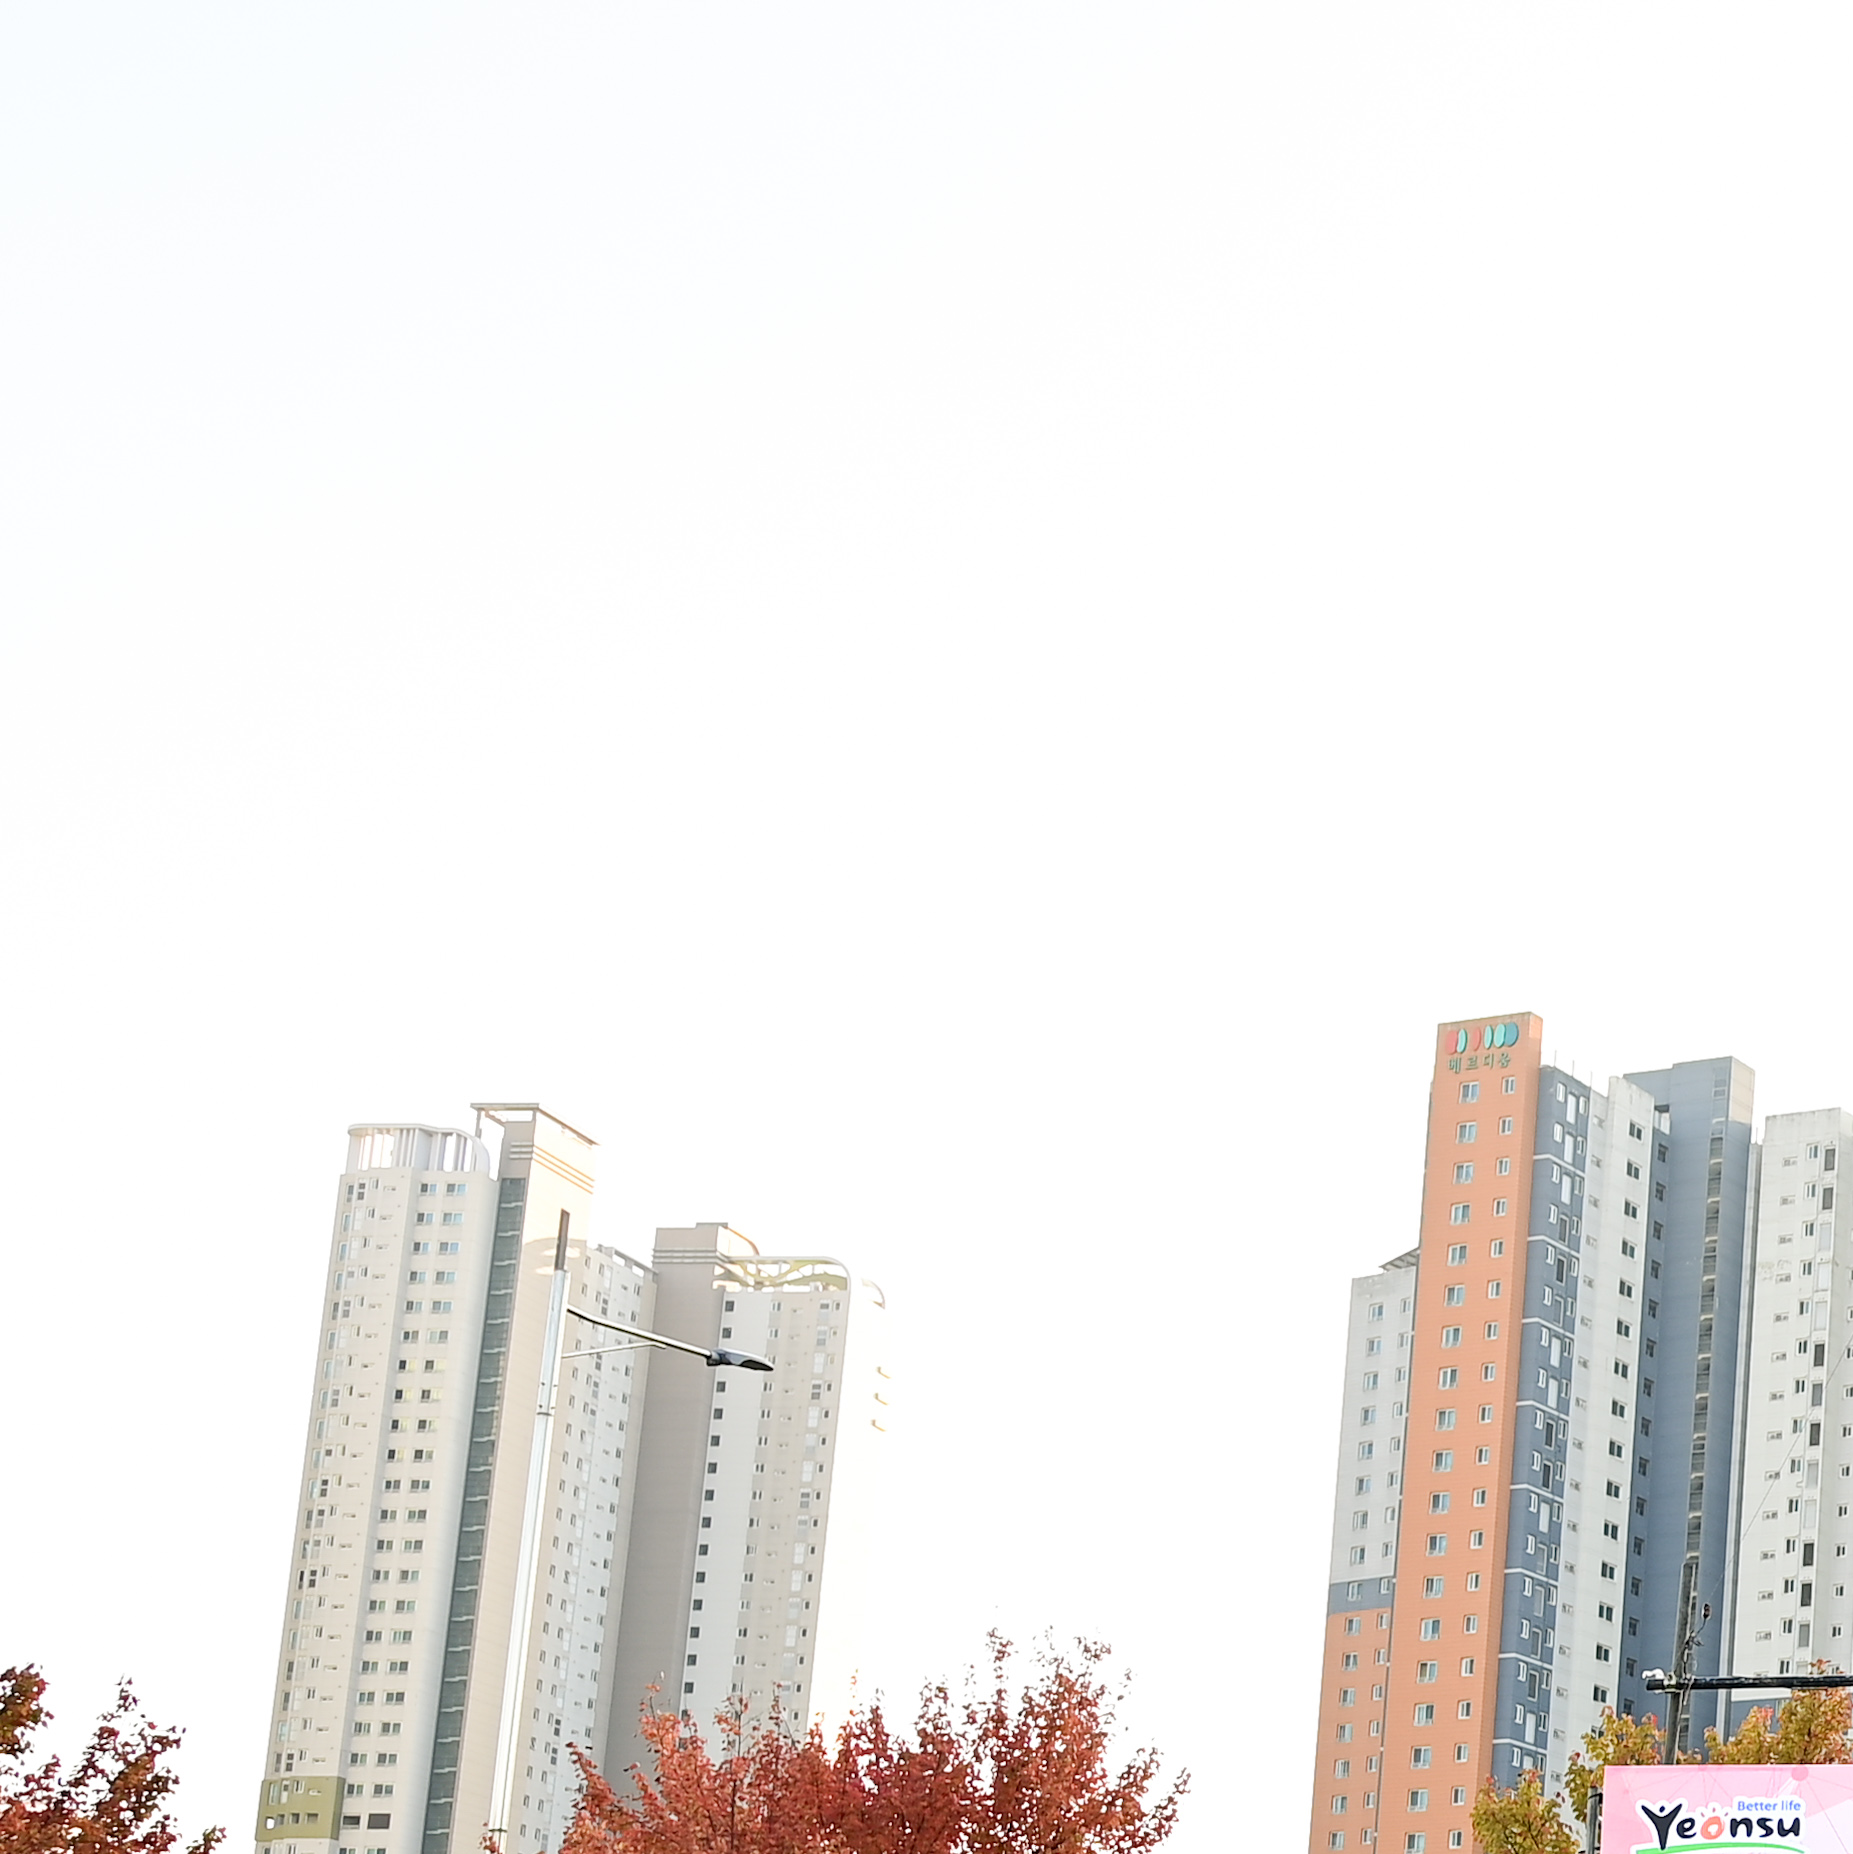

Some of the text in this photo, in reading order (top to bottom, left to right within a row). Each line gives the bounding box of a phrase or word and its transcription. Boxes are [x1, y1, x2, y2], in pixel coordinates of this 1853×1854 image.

[1737, 1800, 1801, 1812] Better life
[1641, 1803, 1801, 1851] Yeonsu
